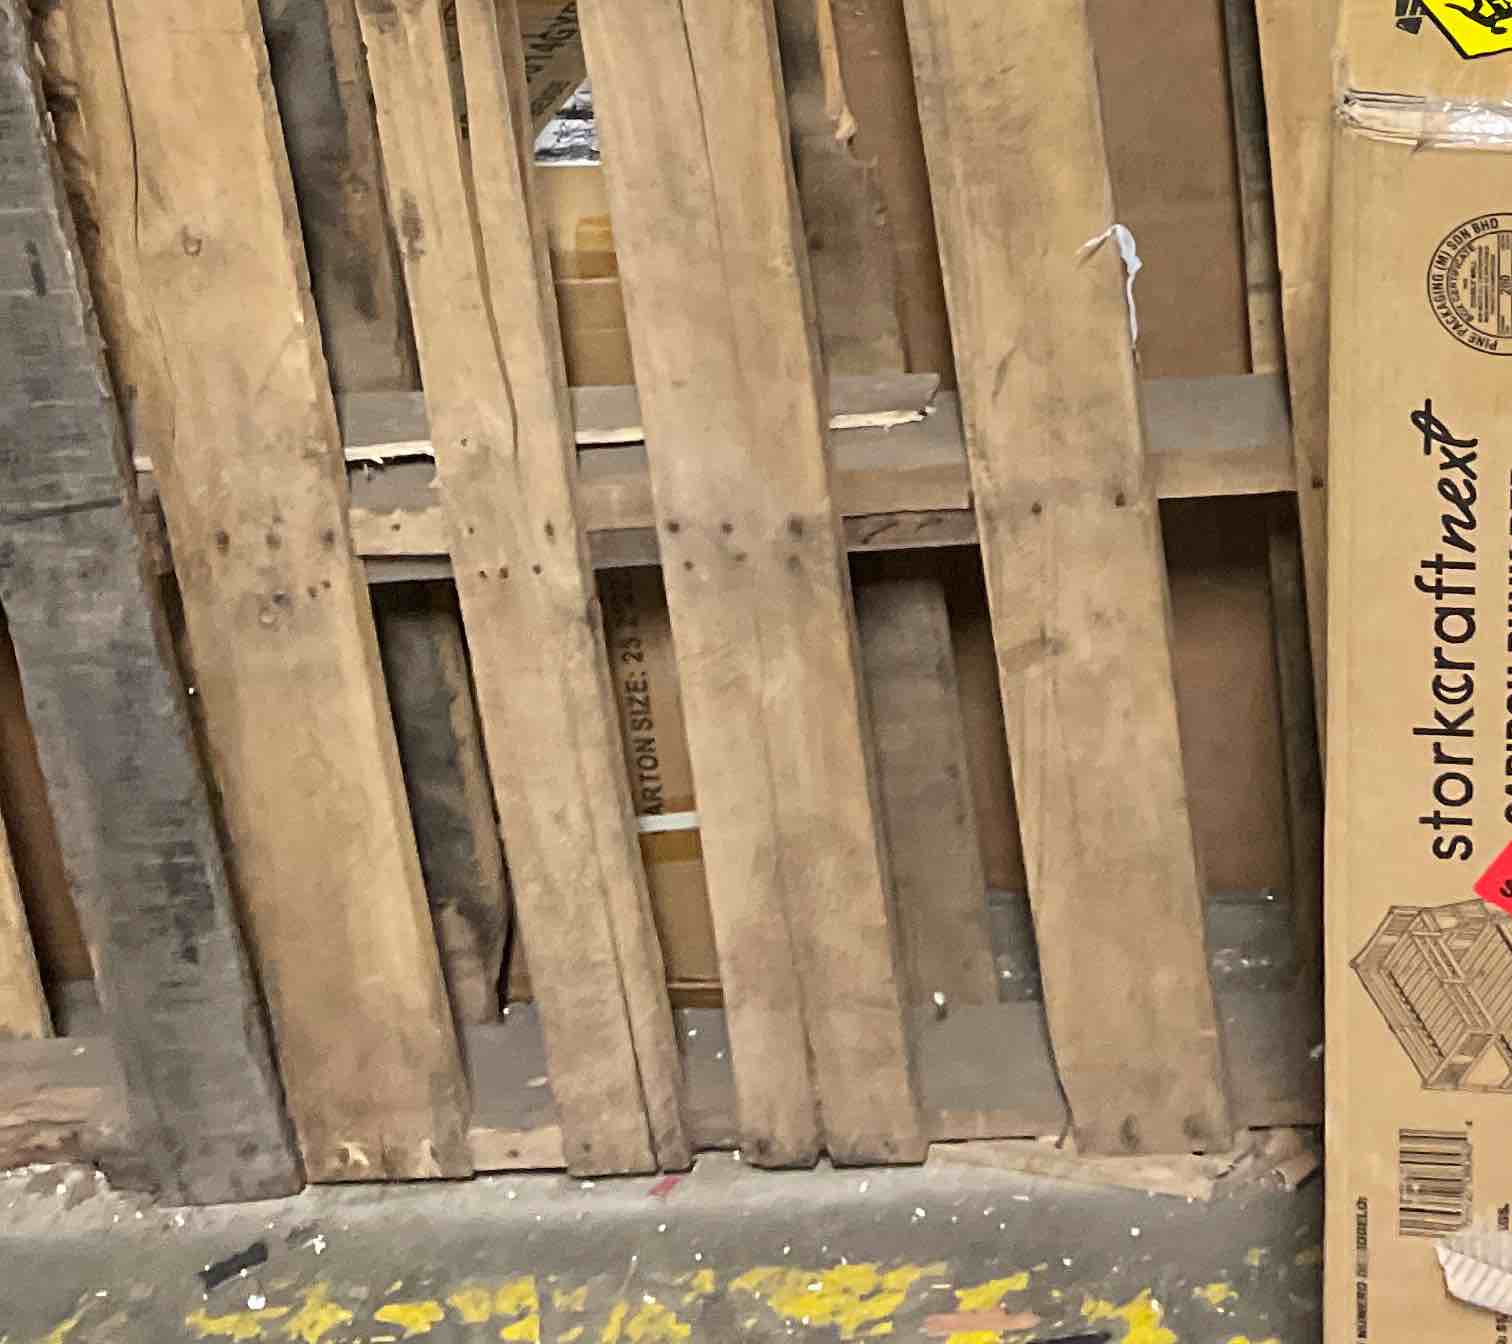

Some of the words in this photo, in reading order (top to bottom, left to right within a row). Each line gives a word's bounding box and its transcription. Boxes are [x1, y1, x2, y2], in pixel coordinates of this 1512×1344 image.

[1469, 216, 1499, 235] BHD
[1445, 226, 1470, 251] SDN
[1432, 250, 1453, 272] (M)
[1430, 273, 1471, 336] PACKAGING
[1467, 334, 1499, 351] PINE
[624, 671, 653, 732] SIZE:
[635, 735, 664, 817] ARTON
